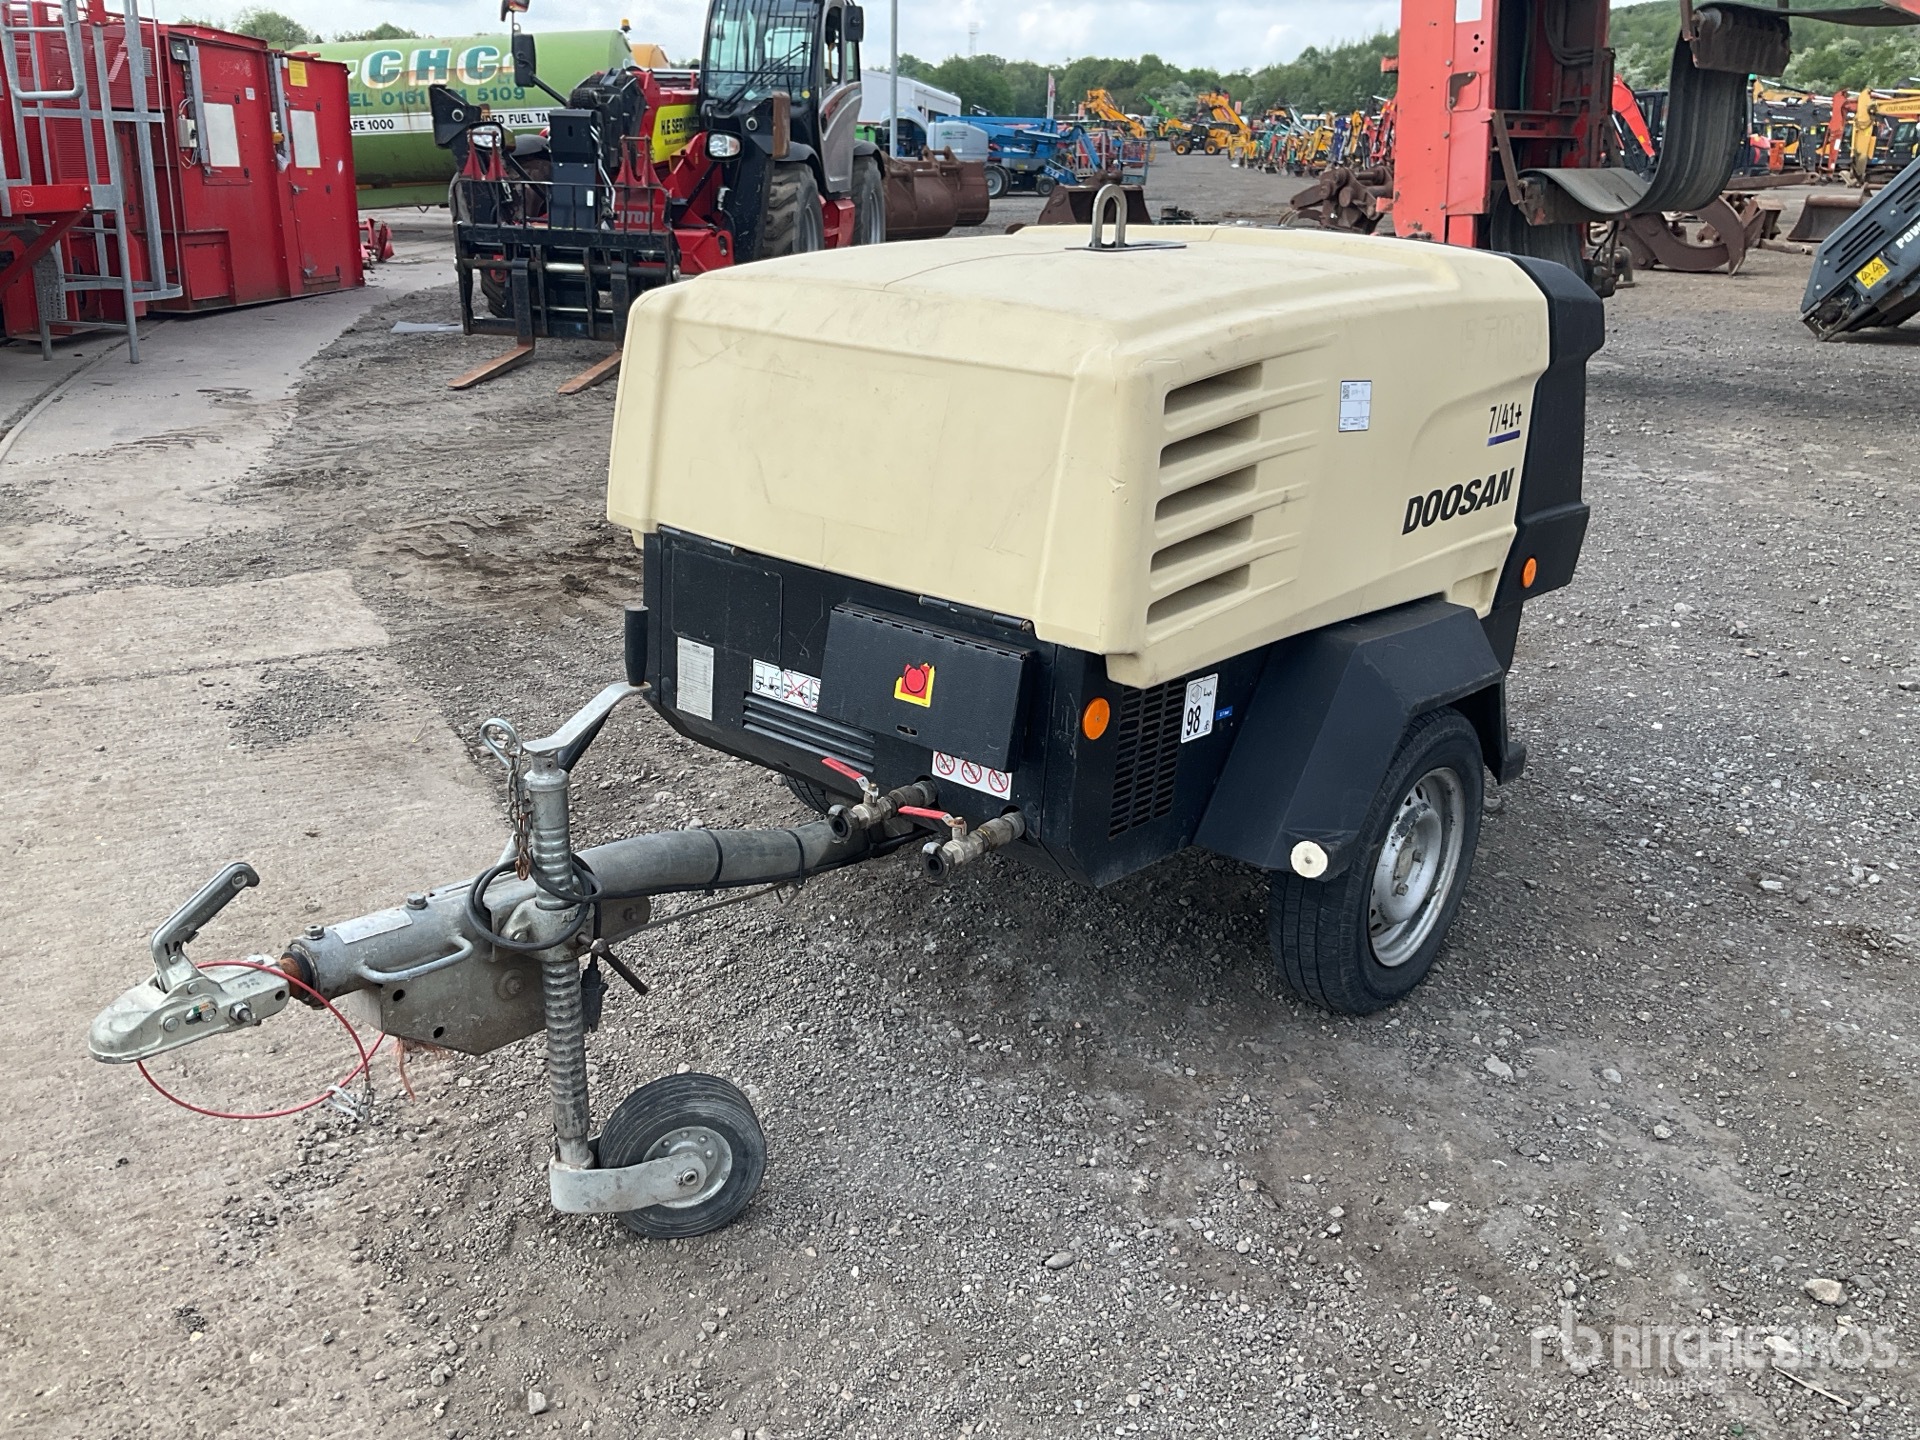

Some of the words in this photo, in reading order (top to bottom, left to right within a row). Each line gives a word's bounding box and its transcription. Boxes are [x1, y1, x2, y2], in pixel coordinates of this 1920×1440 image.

[349, 92, 373, 107] EL
[477, 86, 525, 102] 5109
[367, 119, 394, 131] 1000
[508, 113, 533, 125] FUEL
[535, 112, 550, 123] TA
[1489, 401, 1522, 434] 7/41+
[1401, 467, 1515, 535] DOOSAN
[1186, 704, 1202, 736] 98
